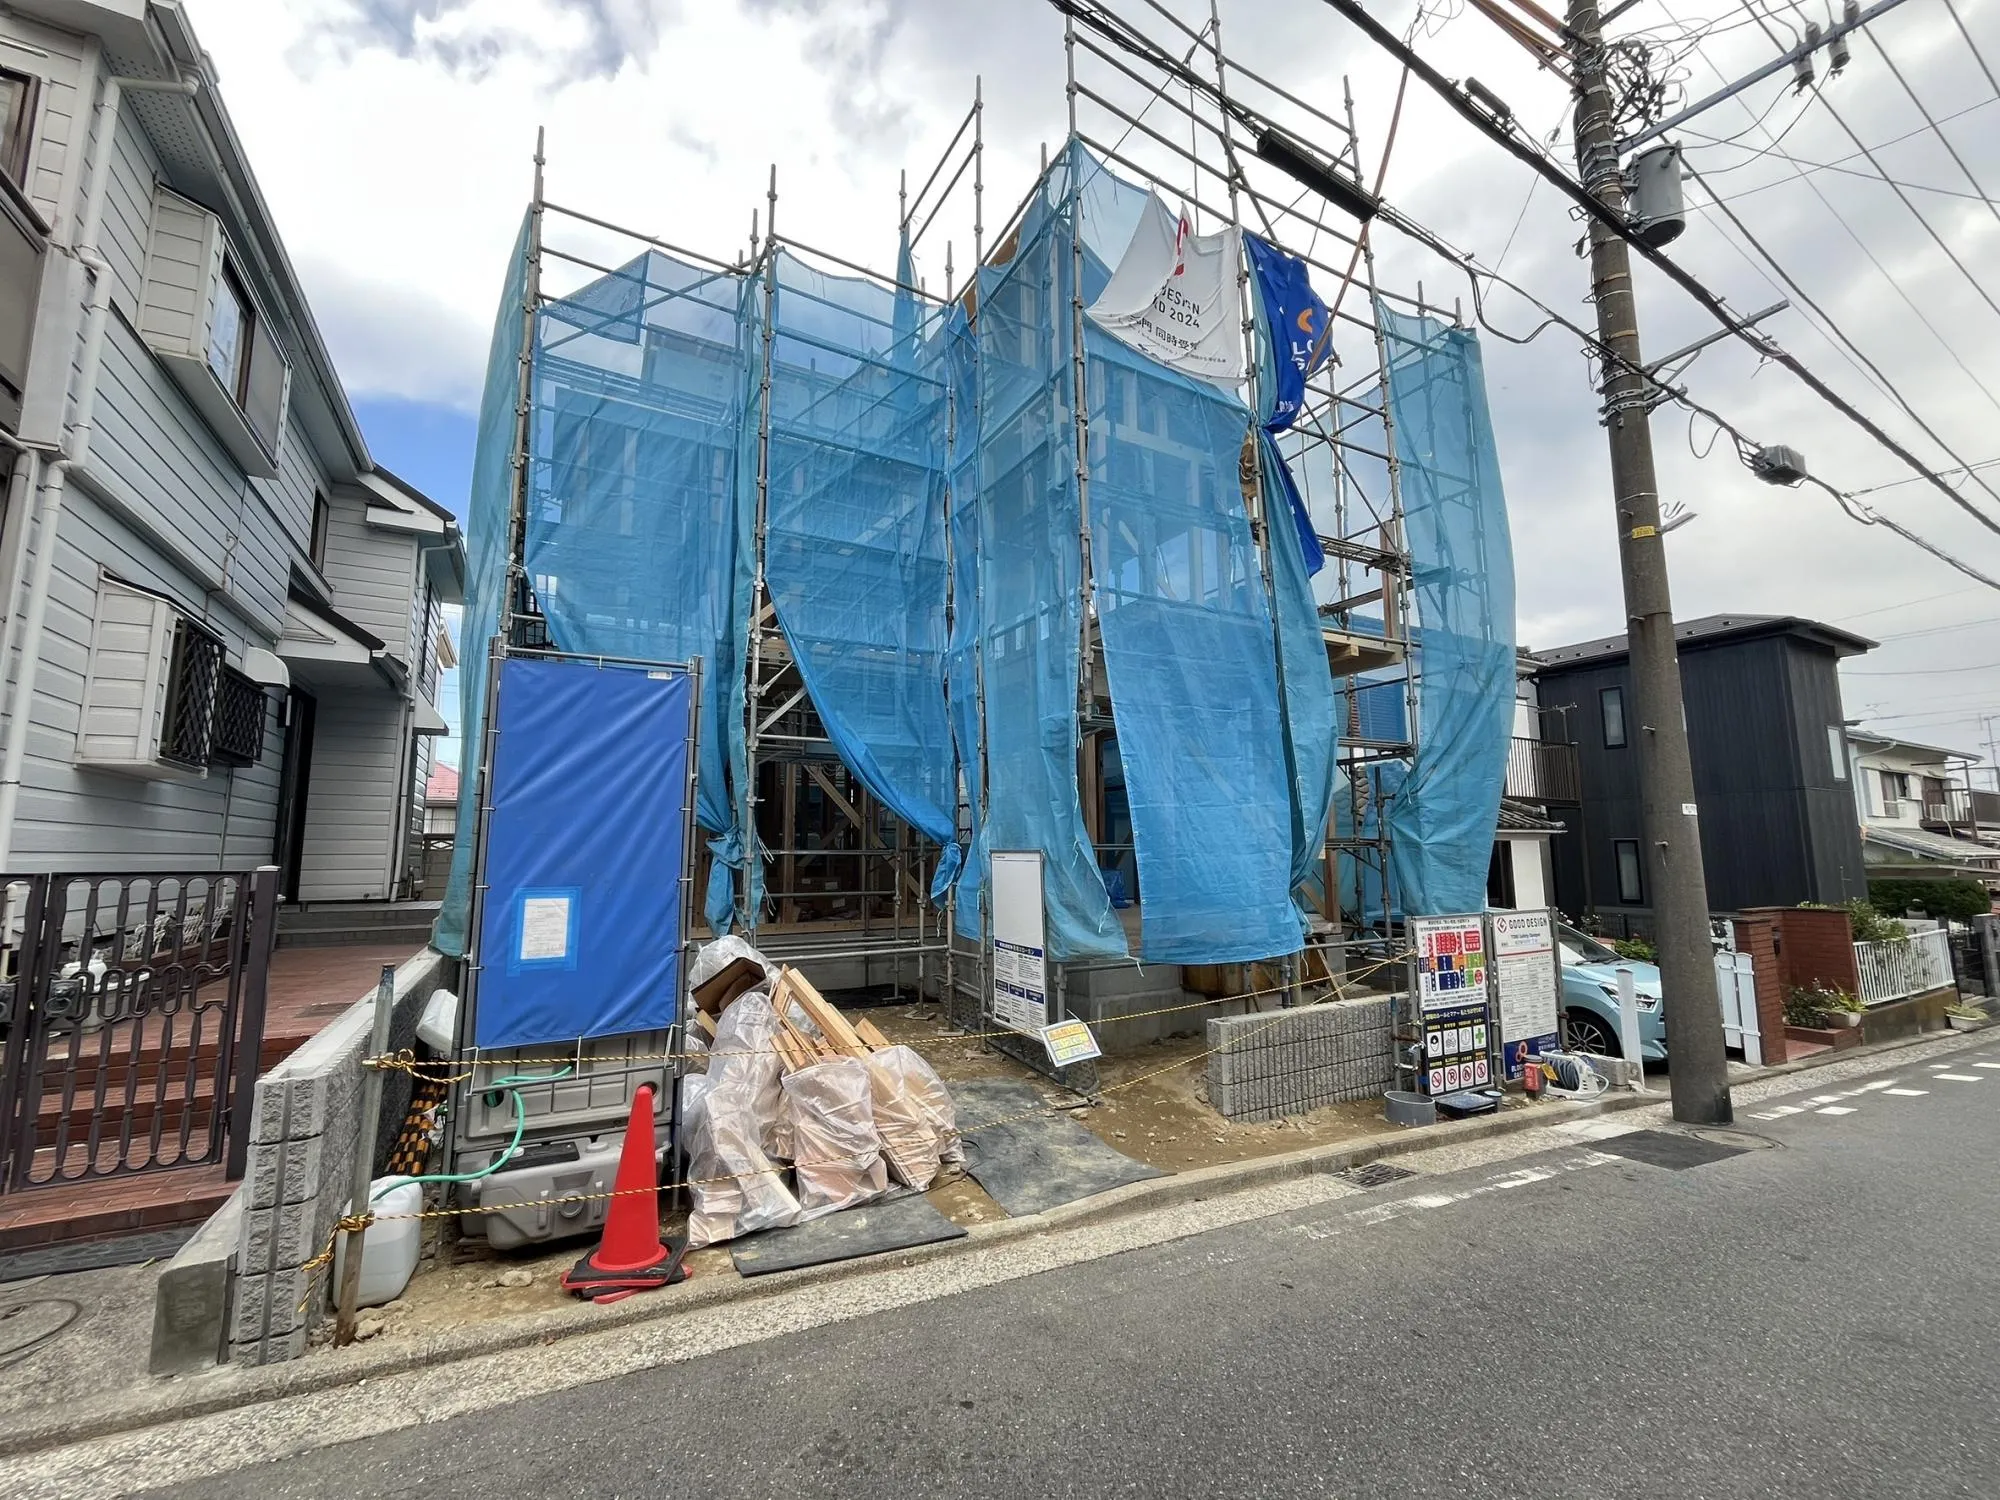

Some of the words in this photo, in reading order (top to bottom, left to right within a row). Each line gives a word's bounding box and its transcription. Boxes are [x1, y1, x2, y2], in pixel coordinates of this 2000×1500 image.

[1169, 307, 1200, 329] 2024
[1508, 919, 1526, 930] GOOD
[1526, 917, 1548, 928] DESIGN
